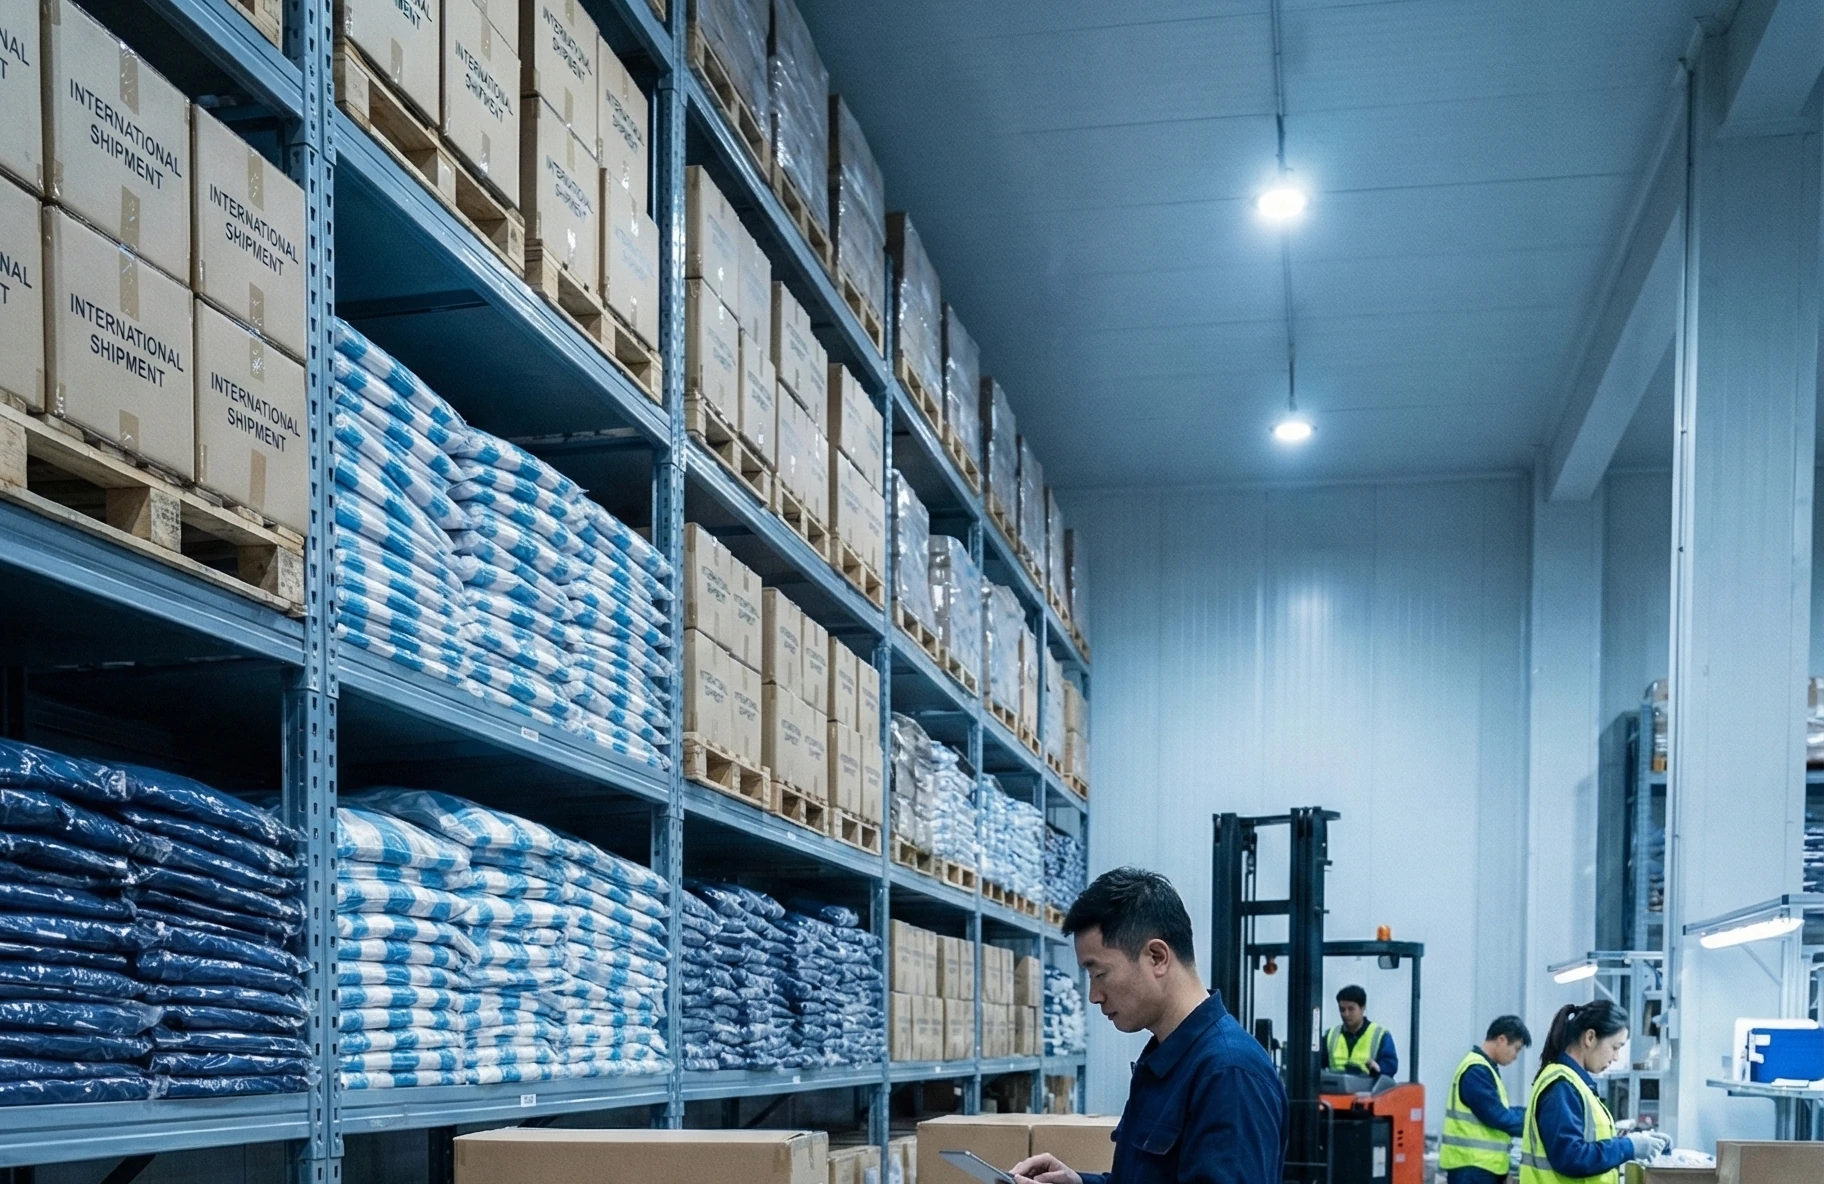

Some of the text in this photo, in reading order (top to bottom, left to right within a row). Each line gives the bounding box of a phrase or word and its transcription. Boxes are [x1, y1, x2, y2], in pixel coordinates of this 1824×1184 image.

[70, 78, 182, 178] INTERNATIONAL
[90, 123, 164, 189] SHIPMENT
[210, 183, 299, 264] INTERNATIONAL
[225, 222, 284, 276] SHIPMENT
[70, 293, 184, 373] INTERNATIONAL
[90, 333, 165, 388] SHIPMENT
[211, 371, 300, 438] INTERNATIONAL
[227, 407, 286, 452] SHIPMENT
